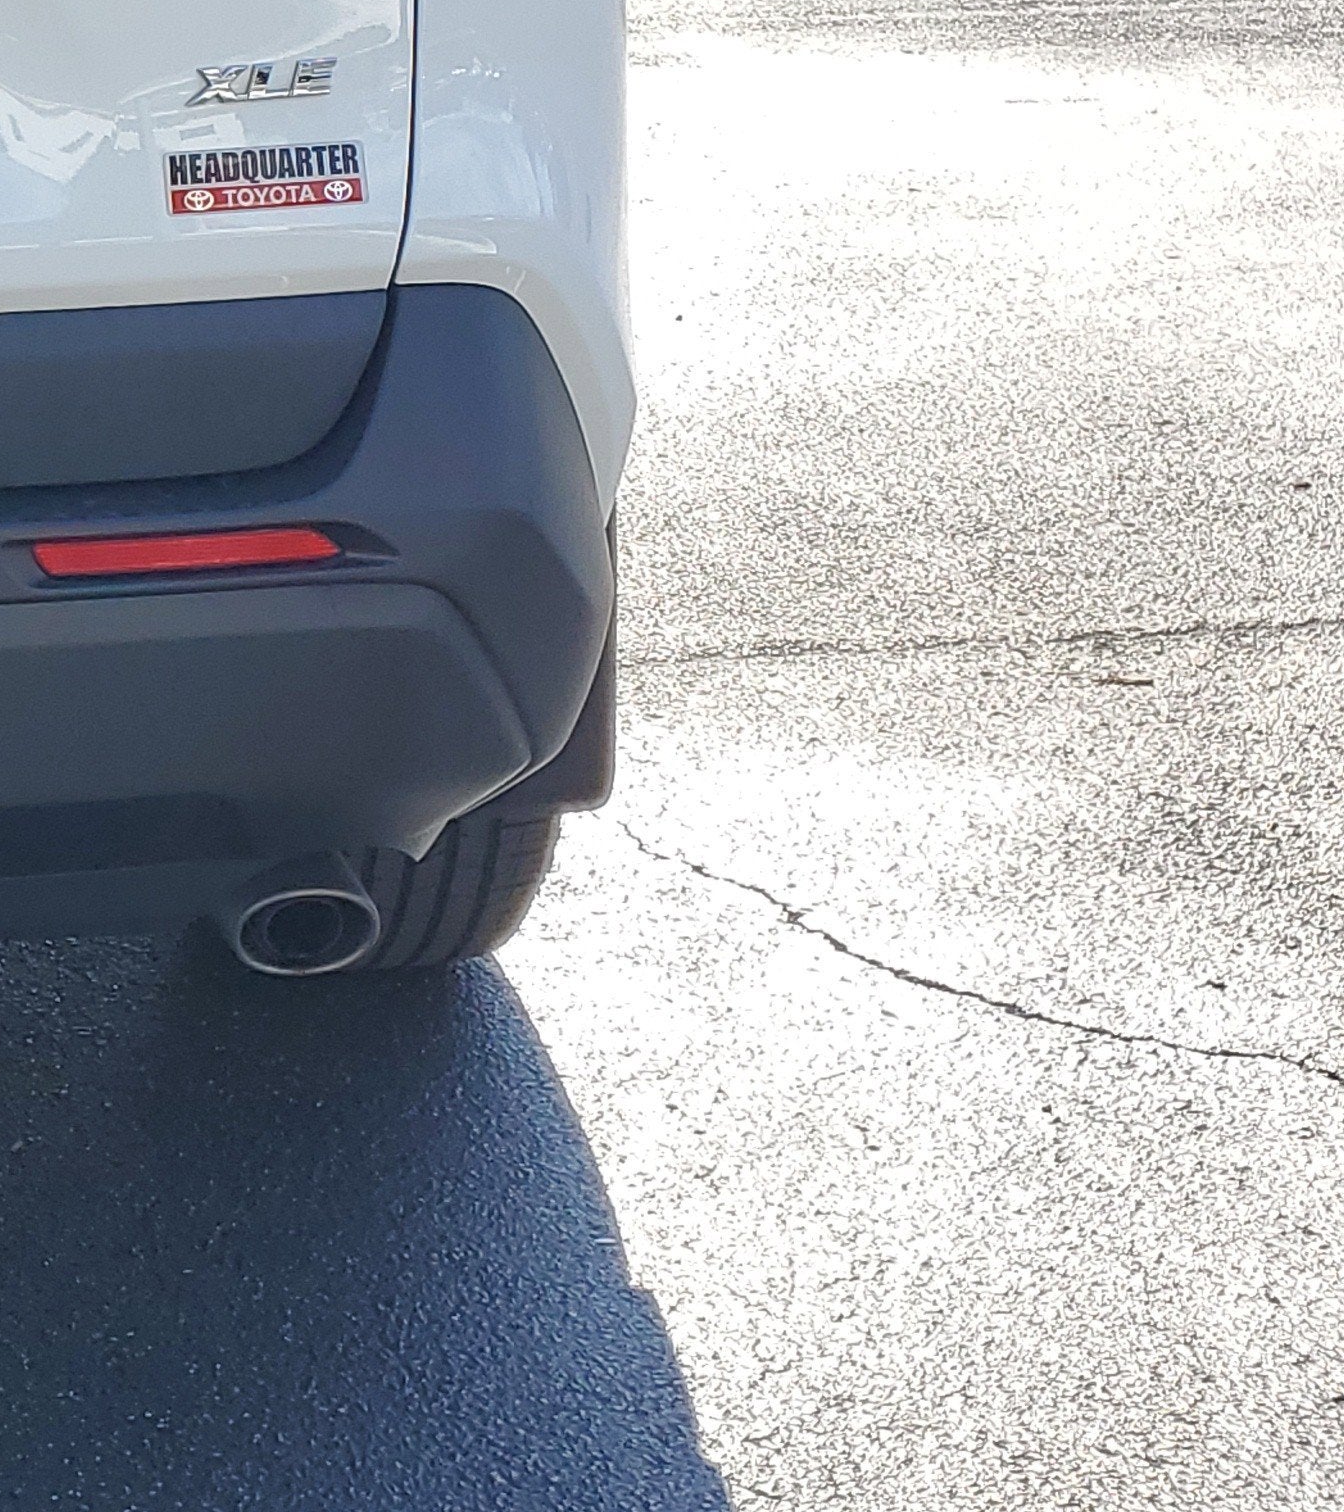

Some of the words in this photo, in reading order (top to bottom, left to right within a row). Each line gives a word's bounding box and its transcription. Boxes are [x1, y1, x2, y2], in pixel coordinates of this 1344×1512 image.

[185, 57, 338, 106] XLE
[168, 143, 360, 186] HEADQUARTER
[222, 184, 317, 208] TOYOTA
